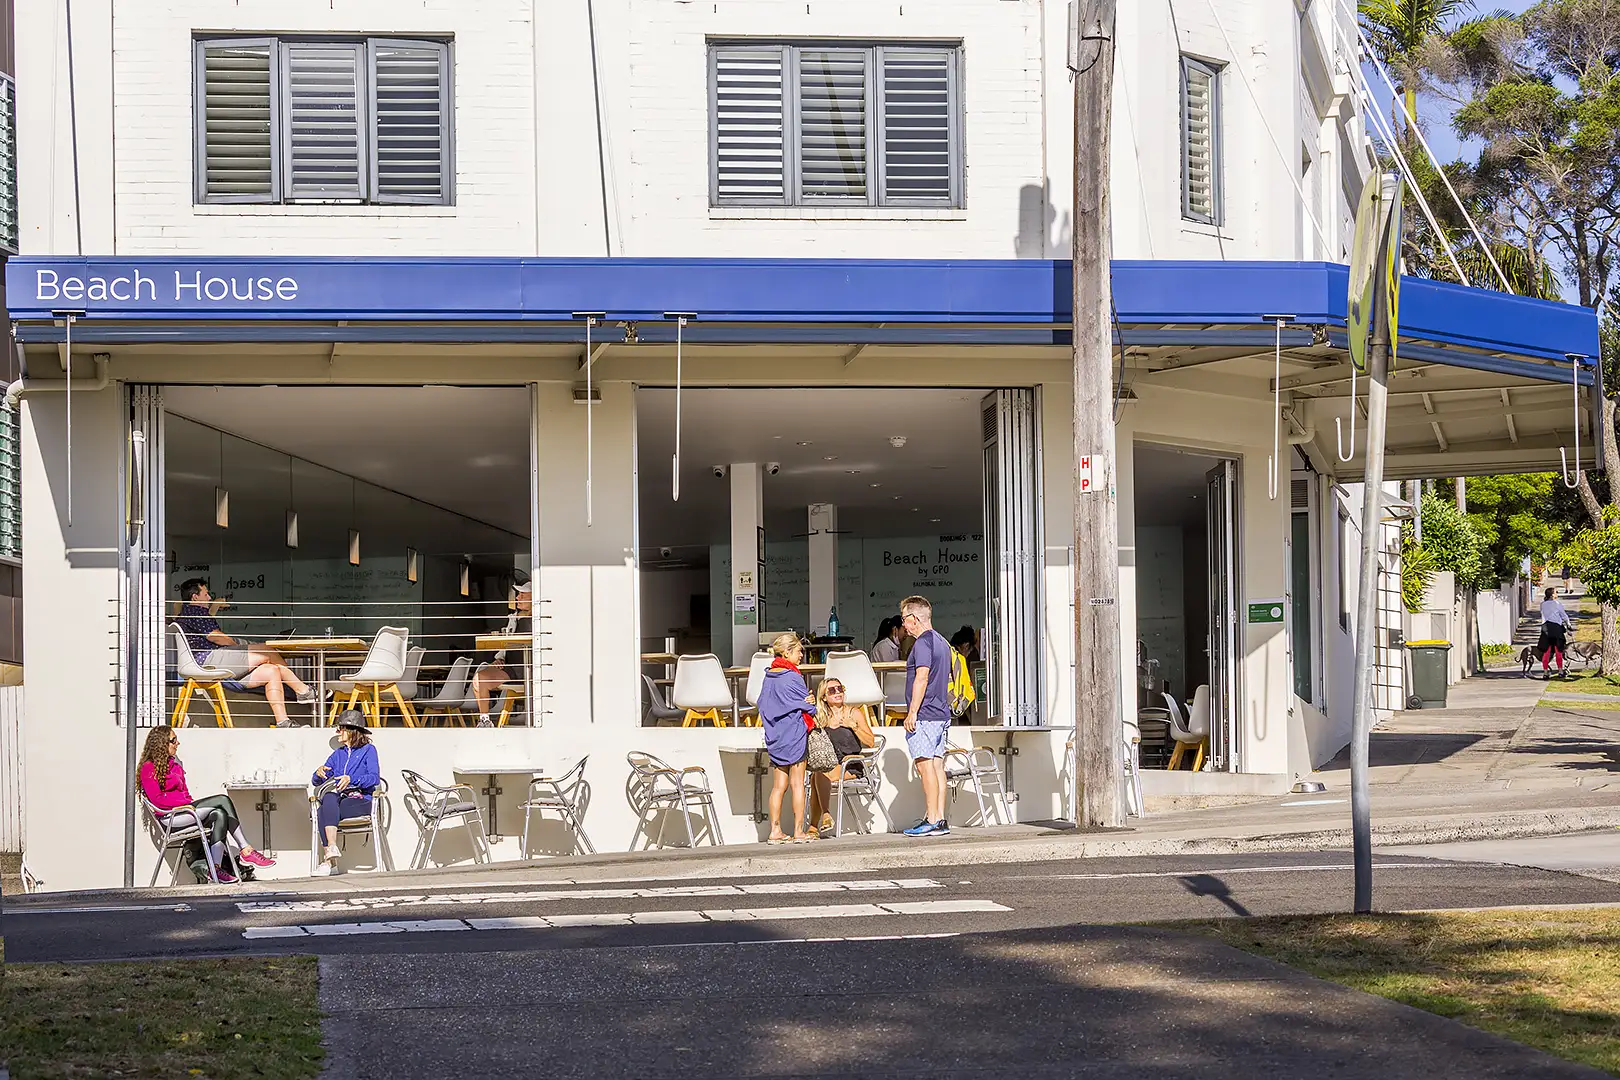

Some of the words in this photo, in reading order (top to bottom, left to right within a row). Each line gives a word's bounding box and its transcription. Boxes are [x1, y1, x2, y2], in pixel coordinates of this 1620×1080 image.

[36, 269, 157, 301] Beach
[174, 270, 299, 301] House
[883, 550, 927, 566] Beach
[938, 548, 978, 563] House
[918, 566, 928, 577] by
[932, 565, 949, 574] GPO
